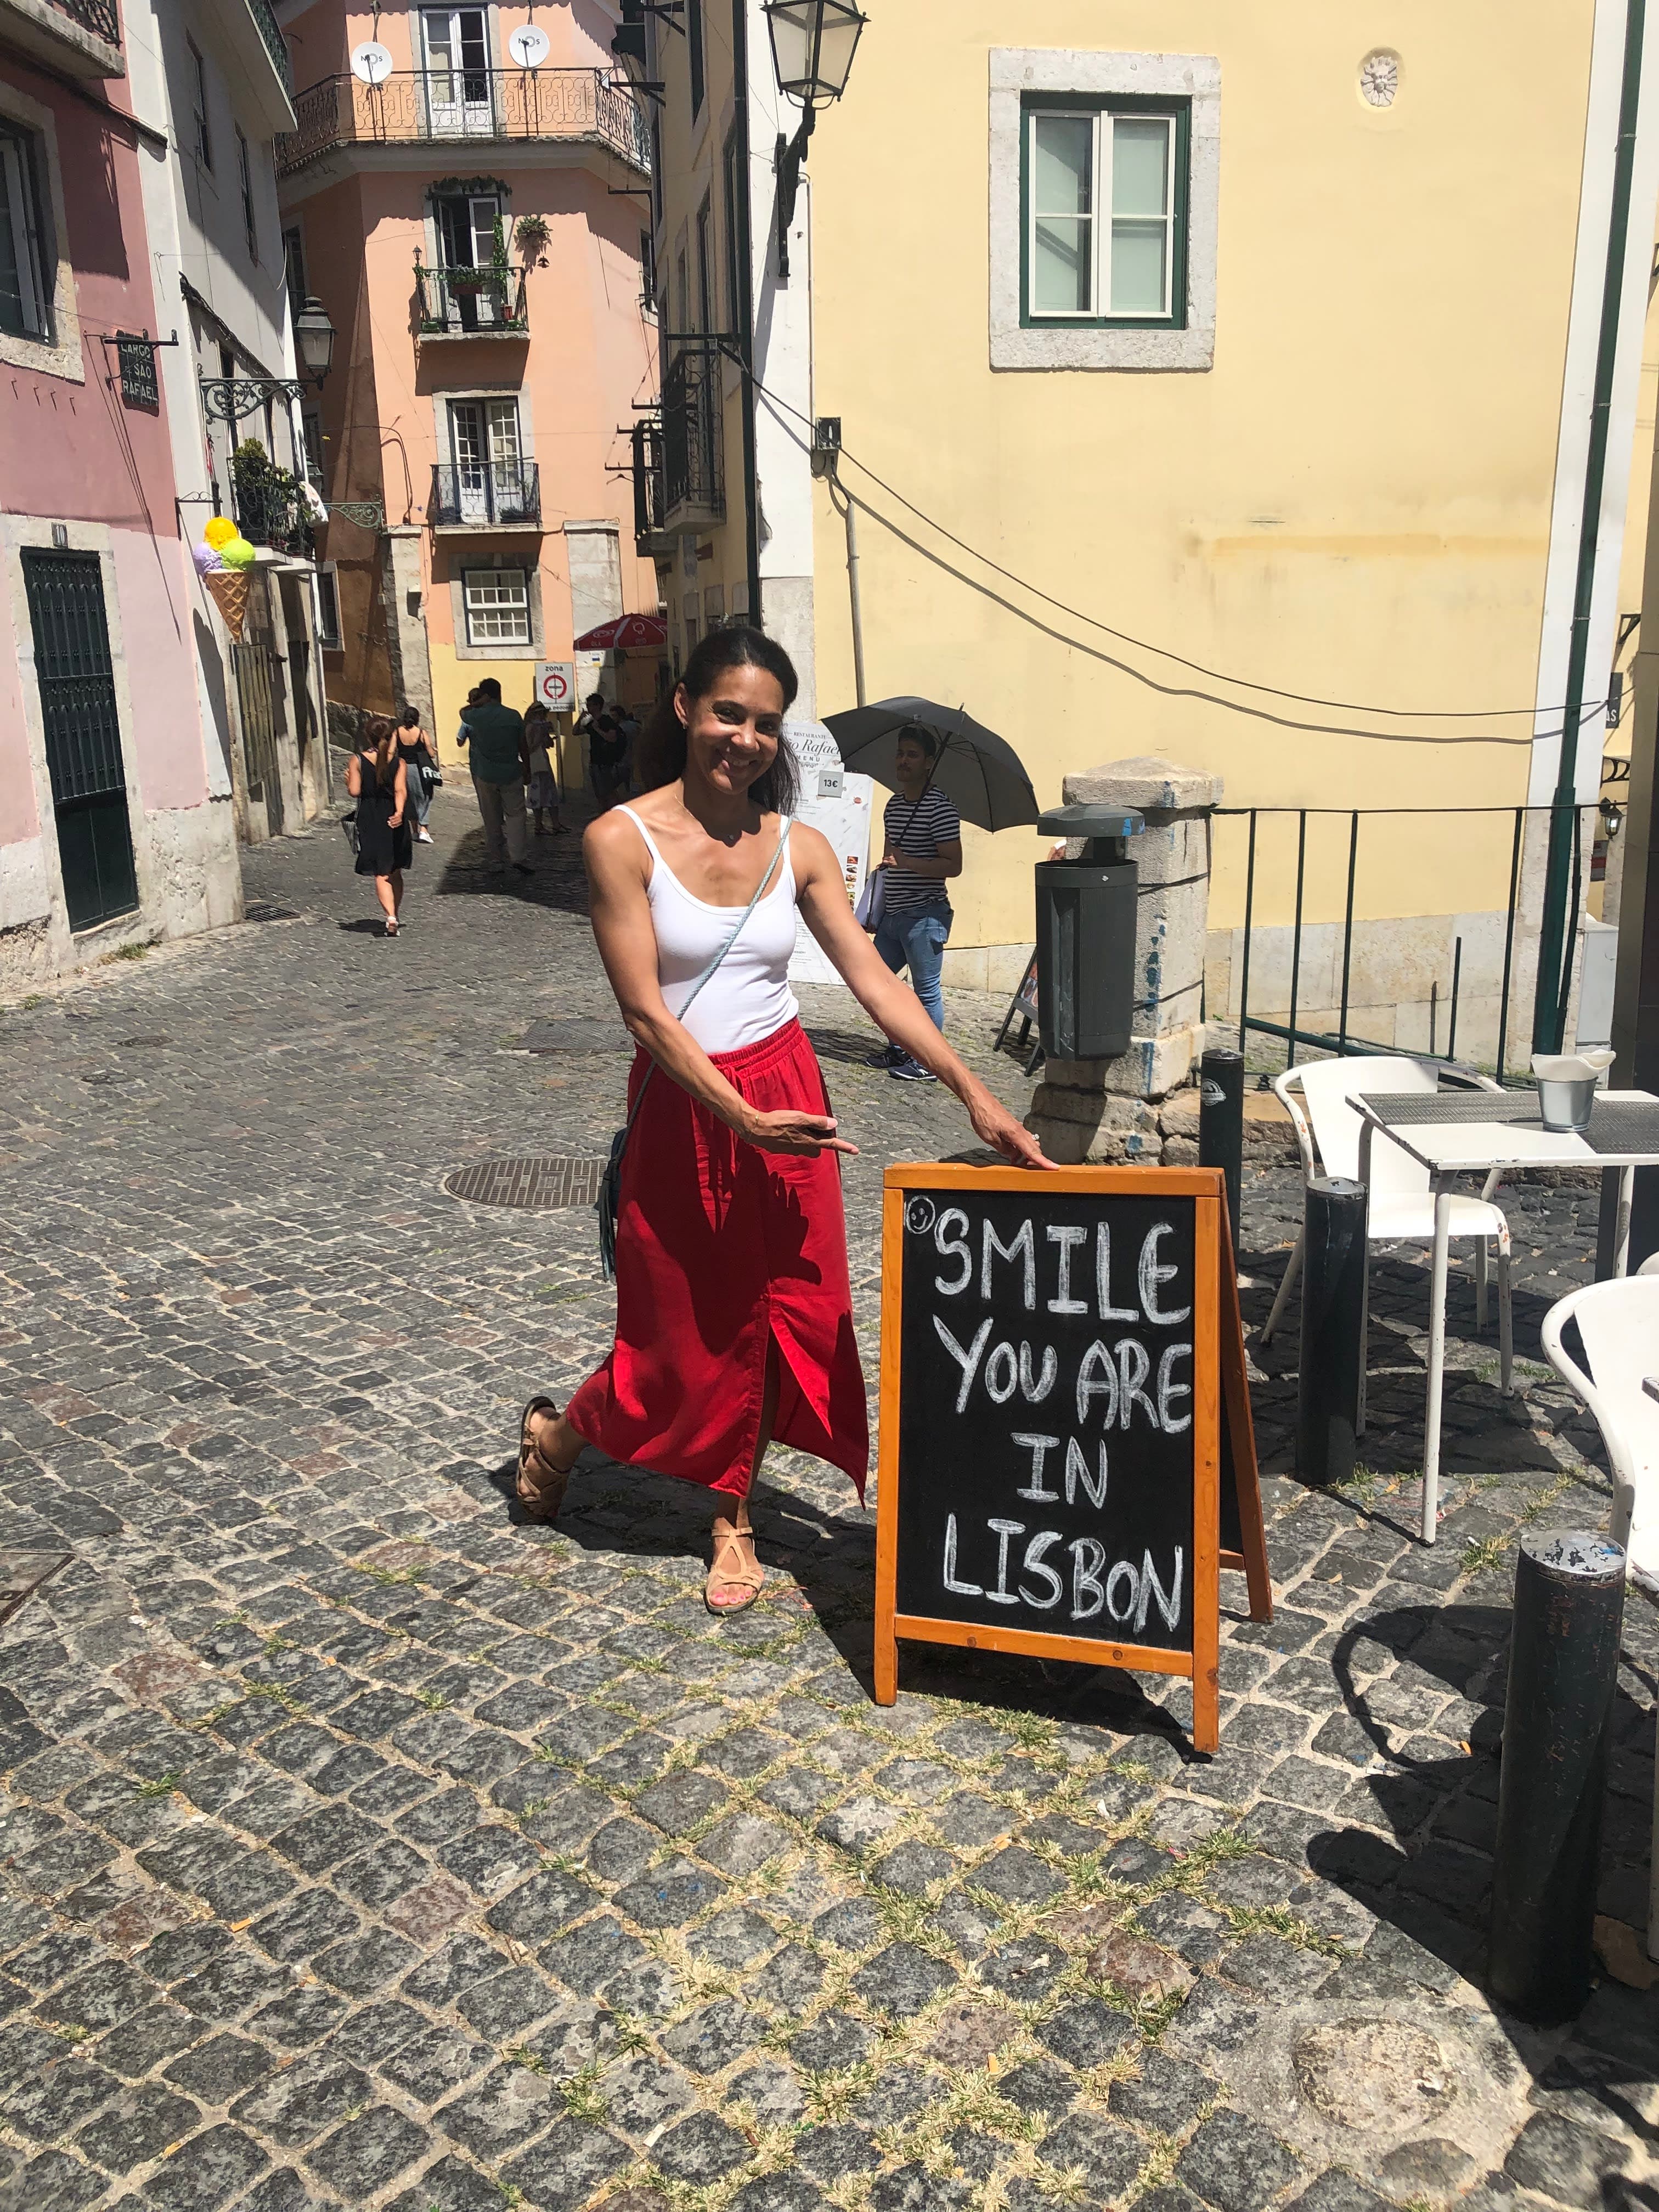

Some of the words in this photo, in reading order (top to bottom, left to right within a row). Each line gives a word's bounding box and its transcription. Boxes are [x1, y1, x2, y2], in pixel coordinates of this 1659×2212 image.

[121, 344, 151, 359] LARGO
[134, 361, 151, 379] SÃO
[123, 380, 158, 401] RAFAEL
[56, 525, 65, 545] 10
[793, 731, 826, 740] RESTAURANTE
[824, 779, 838, 788] 13€
[934, 1207, 1190, 1324] SMILE
[933, 1314, 1057, 1414] YOU
[1076, 1339, 1192, 1434] ARE
[1011, 1432, 1108, 1509] IN
[944, 1513, 1183, 1633] LISBON
